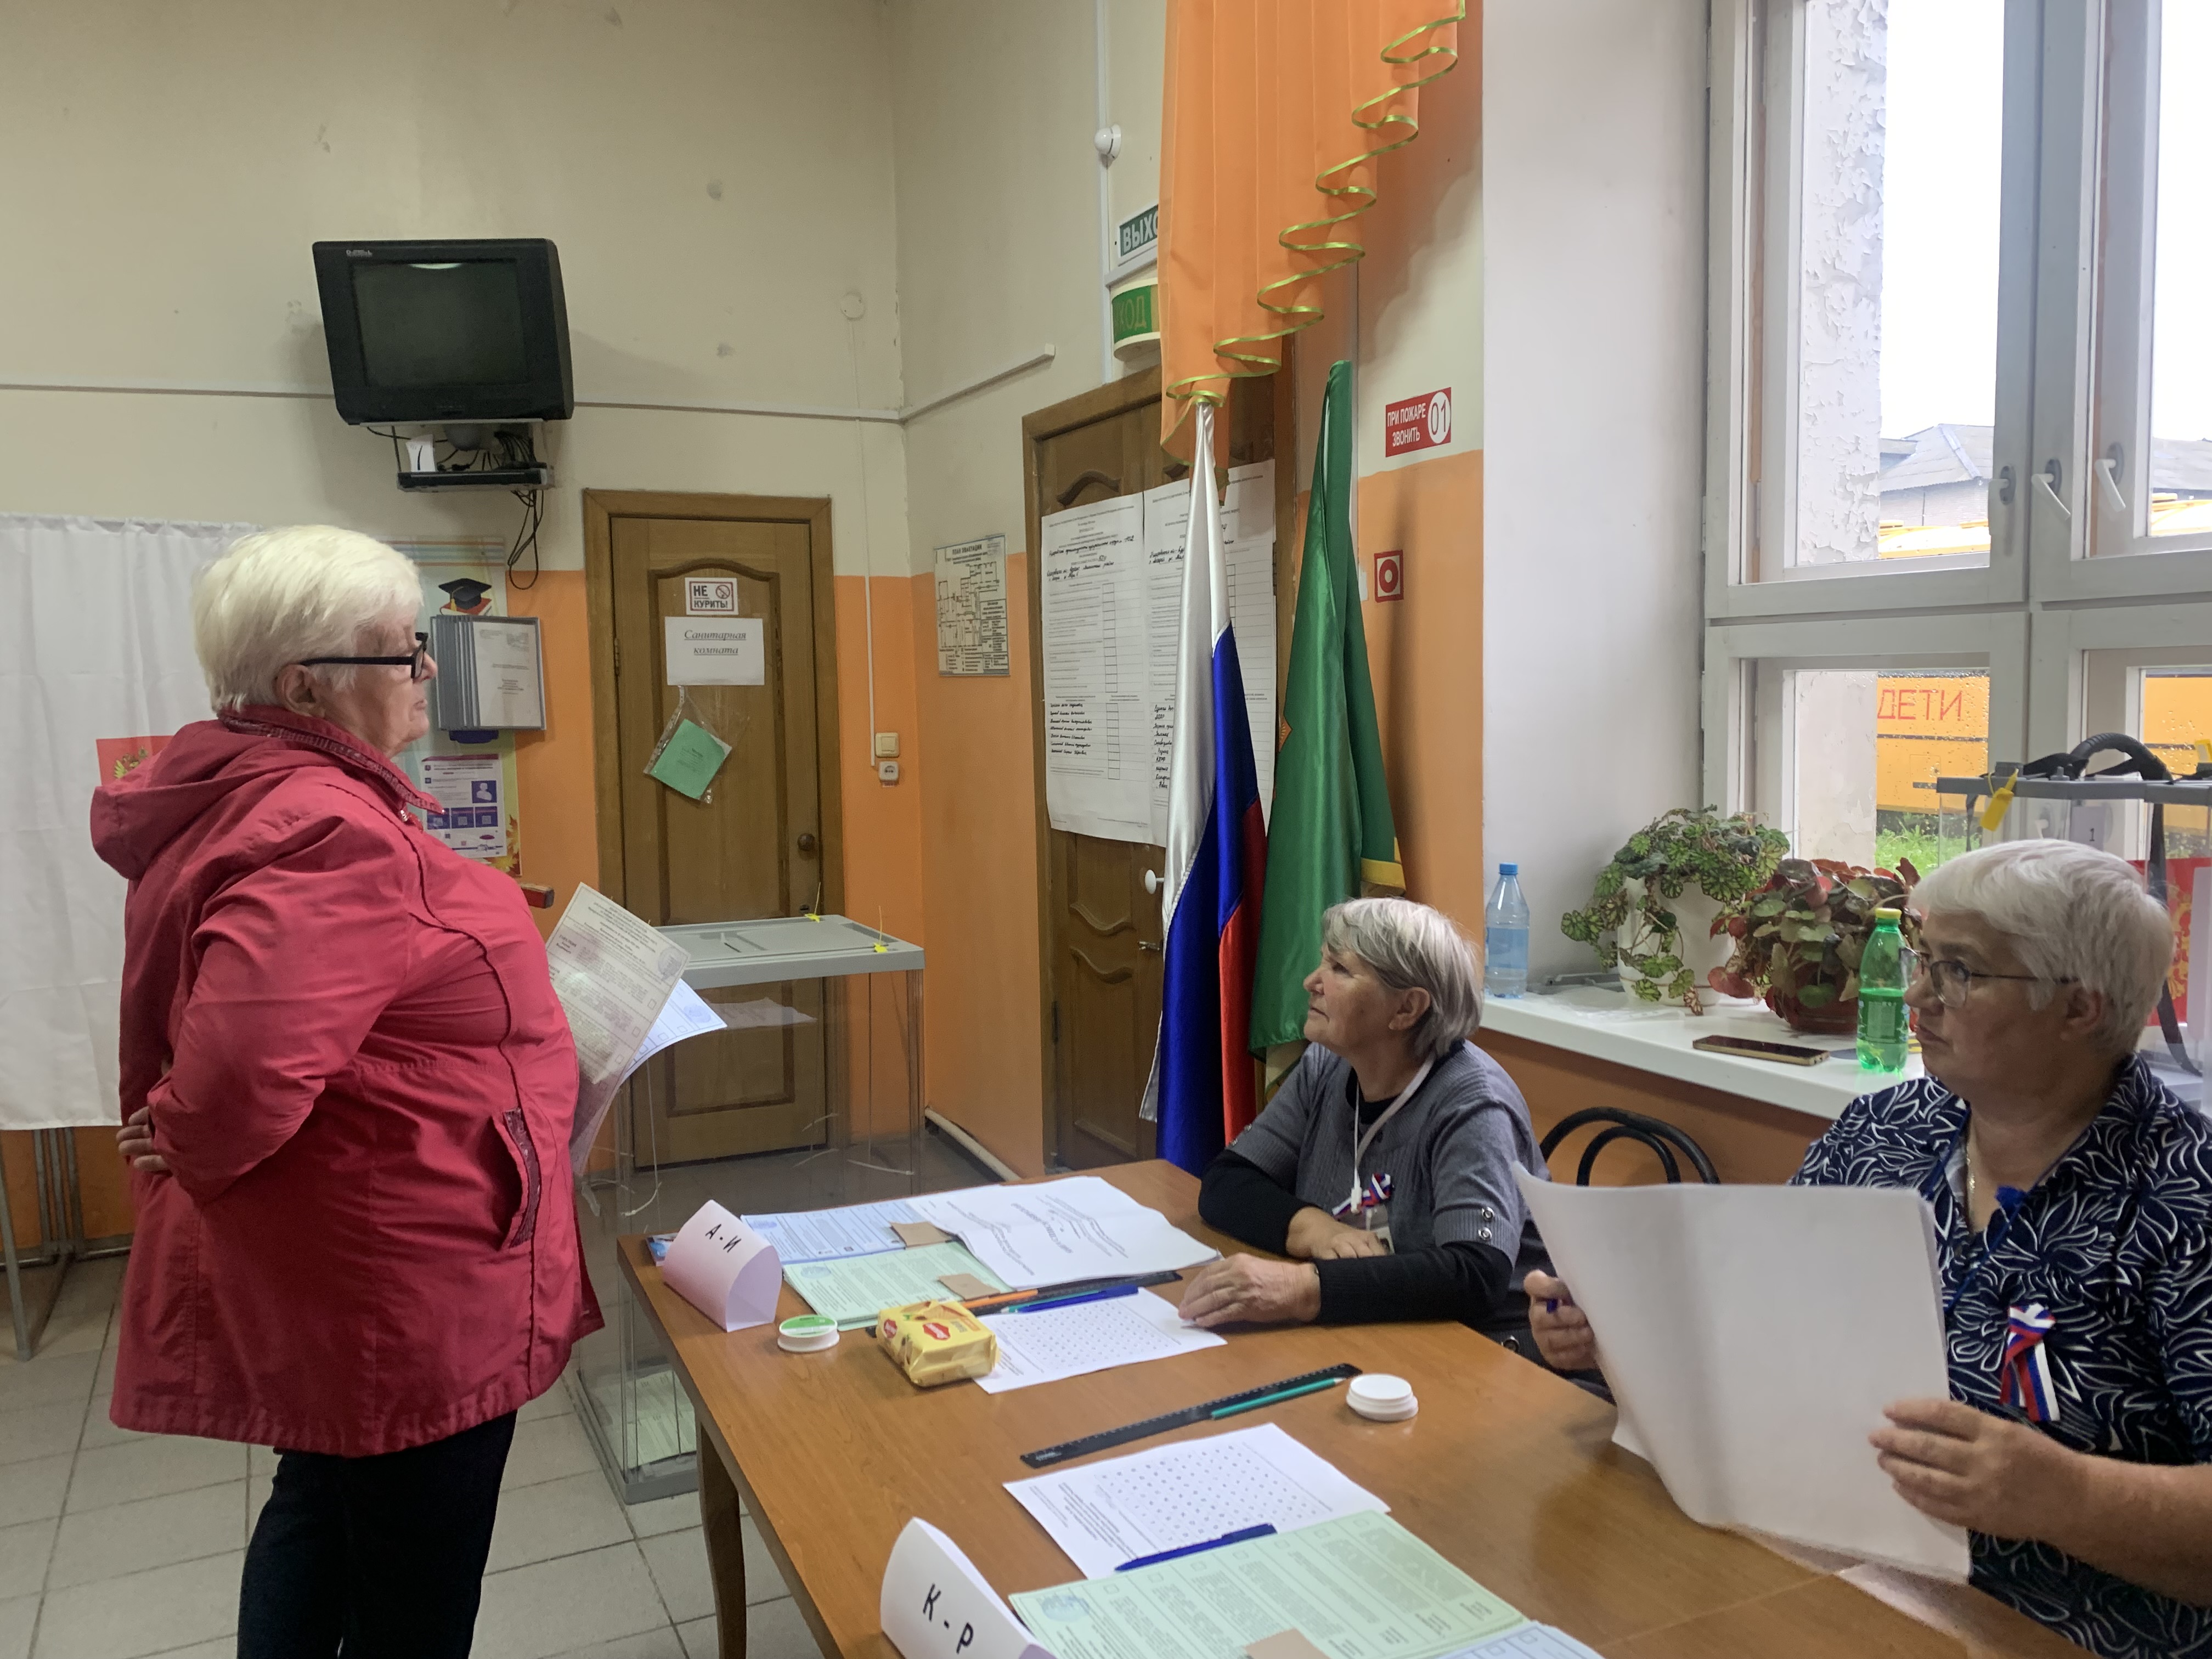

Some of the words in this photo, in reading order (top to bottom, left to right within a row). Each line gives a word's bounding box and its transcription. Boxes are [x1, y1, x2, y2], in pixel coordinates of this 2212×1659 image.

[1387, 410, 1400, 427] ПРИ
[1400, 403, 1426, 424] ПОЖАРЕ
[1431, 399, 1446, 435] 01
[1392, 427, 1420, 447] ЗВОНИТЬ
[693, 585, 708, 597] НЕ
[694, 600, 728, 608] КУРИТЬ!
[684, 630, 747, 641] Санитарная
[1877, 689, 1962, 721] ДЕТИ
